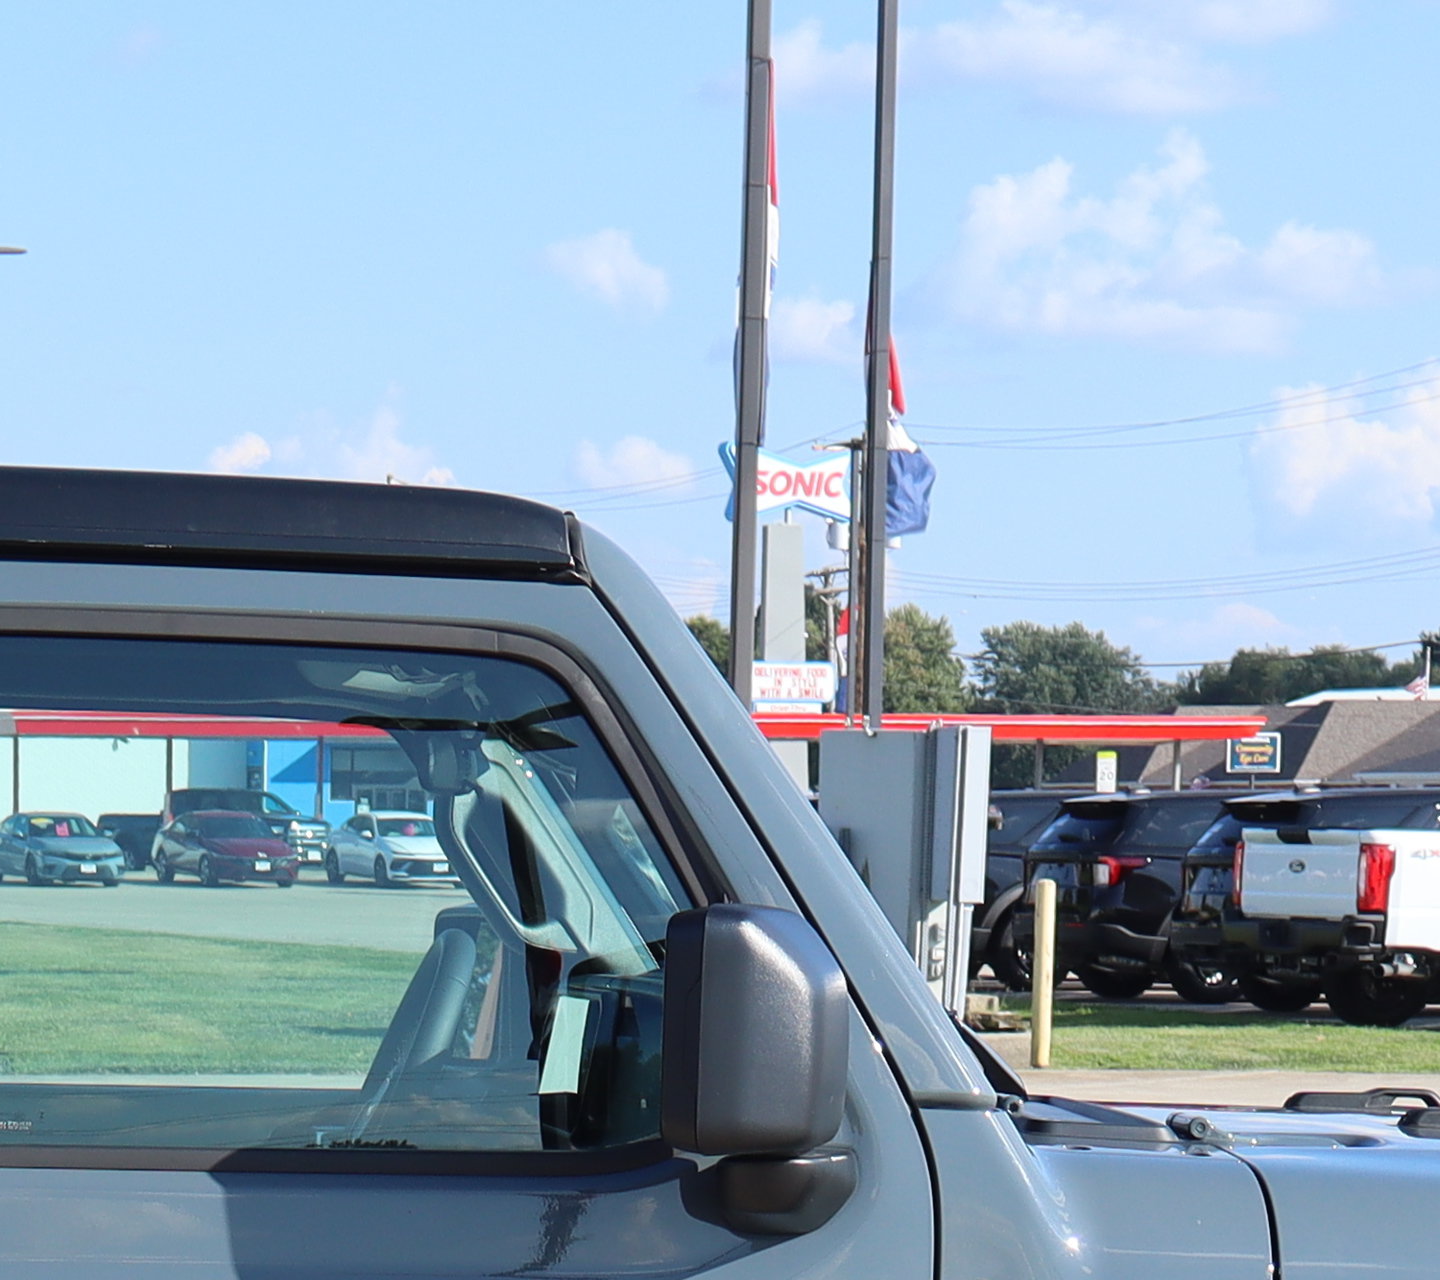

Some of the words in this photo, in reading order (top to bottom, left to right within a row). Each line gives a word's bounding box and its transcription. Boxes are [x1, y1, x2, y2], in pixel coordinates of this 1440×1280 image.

[755, 470, 844, 498] SONIC
[754, 667, 801, 677] DELIVERING
[807, 667, 827, 677] FOOD
[760, 688, 781, 697] WITH
[787, 688, 793, 697] A
[799, 688, 824, 698] SMILE
[1100, 771, 1114, 781] 20
